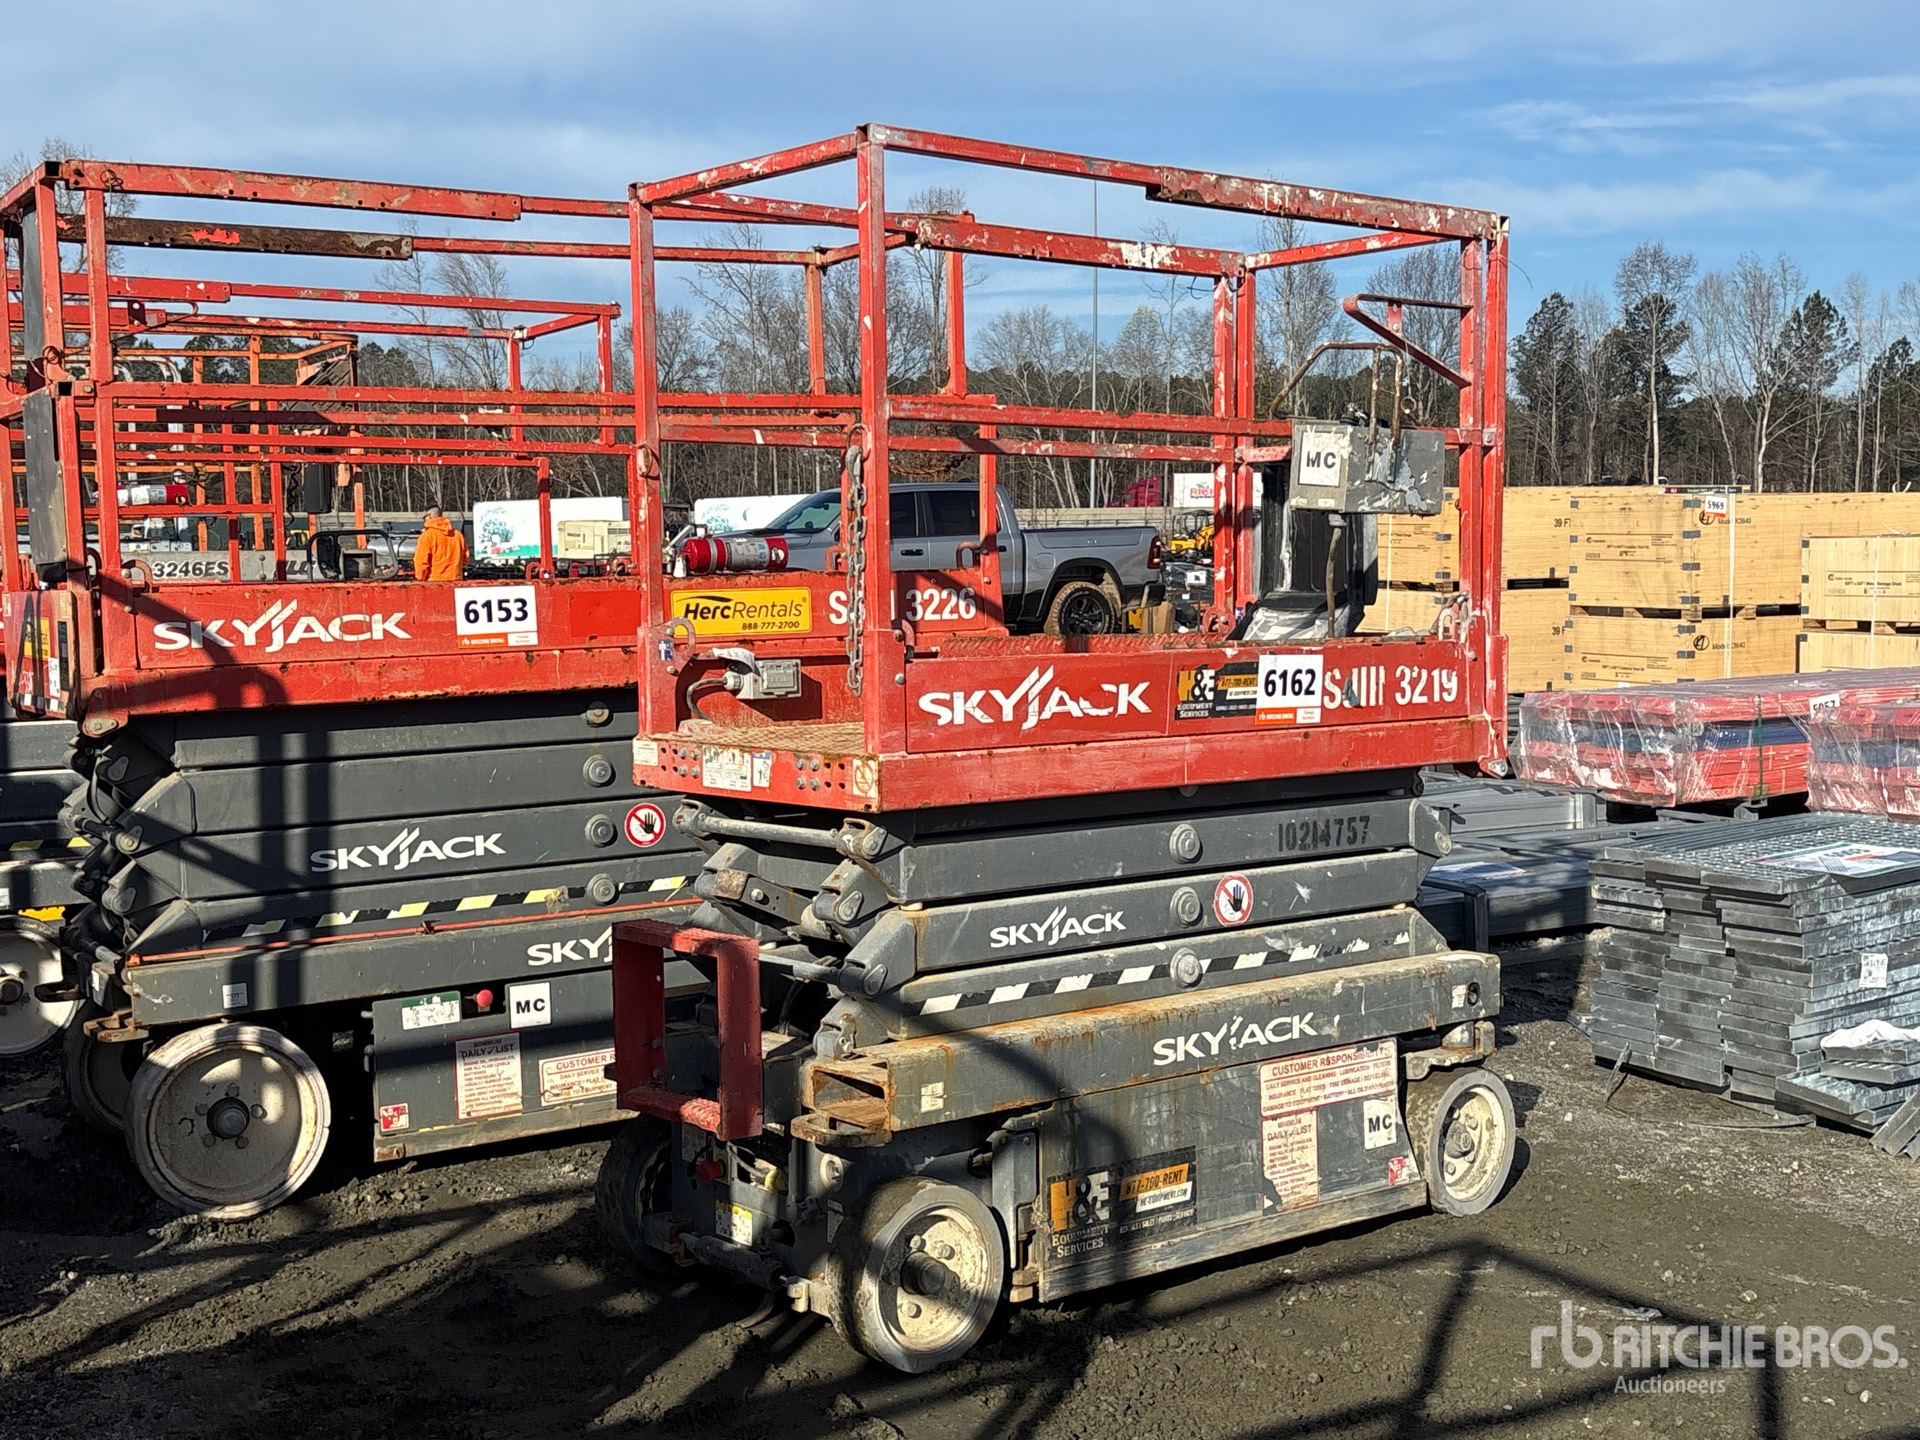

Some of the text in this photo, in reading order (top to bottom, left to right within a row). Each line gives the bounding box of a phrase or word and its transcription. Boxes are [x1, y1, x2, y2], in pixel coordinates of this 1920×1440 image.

[1306, 450, 1338, 469] MC
[1707, 500, 1724, 510] 5969
[1553, 518, 1563, 528] 39
[153, 561, 229, 578] 3246ES
[463, 597, 529, 624] 6153
[905, 586, 977, 622] 3226
[152, 598, 413, 653] SKYJACK
[741, 621, 800, 630] 888-777-2700
[1264, 668, 1316, 697] 6162
[1394, 665, 1458, 706] 3219
[918, 664, 1152, 731] SKYJACK
[1177, 702, 1214, 711] EQUIPMENT
[1179, 709, 1210, 718] SERVICES
[310, 826, 507, 873] SKYJACK
[989, 905, 1127, 948] SKYJACK
[516, 998, 546, 1015] MC
[461, 1044, 514, 1059] DAILY LIST
[556, 1054, 607, 1071] CUSTOMER
[1272, 1060, 1318, 1077] CUSTOMER
[576, 1068, 600, 1078] SERVICE
[1368, 1113, 1393, 1133] MC
[1267, 1124, 1312, 1141] DAILY LIST
[1050, 1171, 1110, 1232] H&E
[1057, 1237, 1104, 1259] SERVICES
